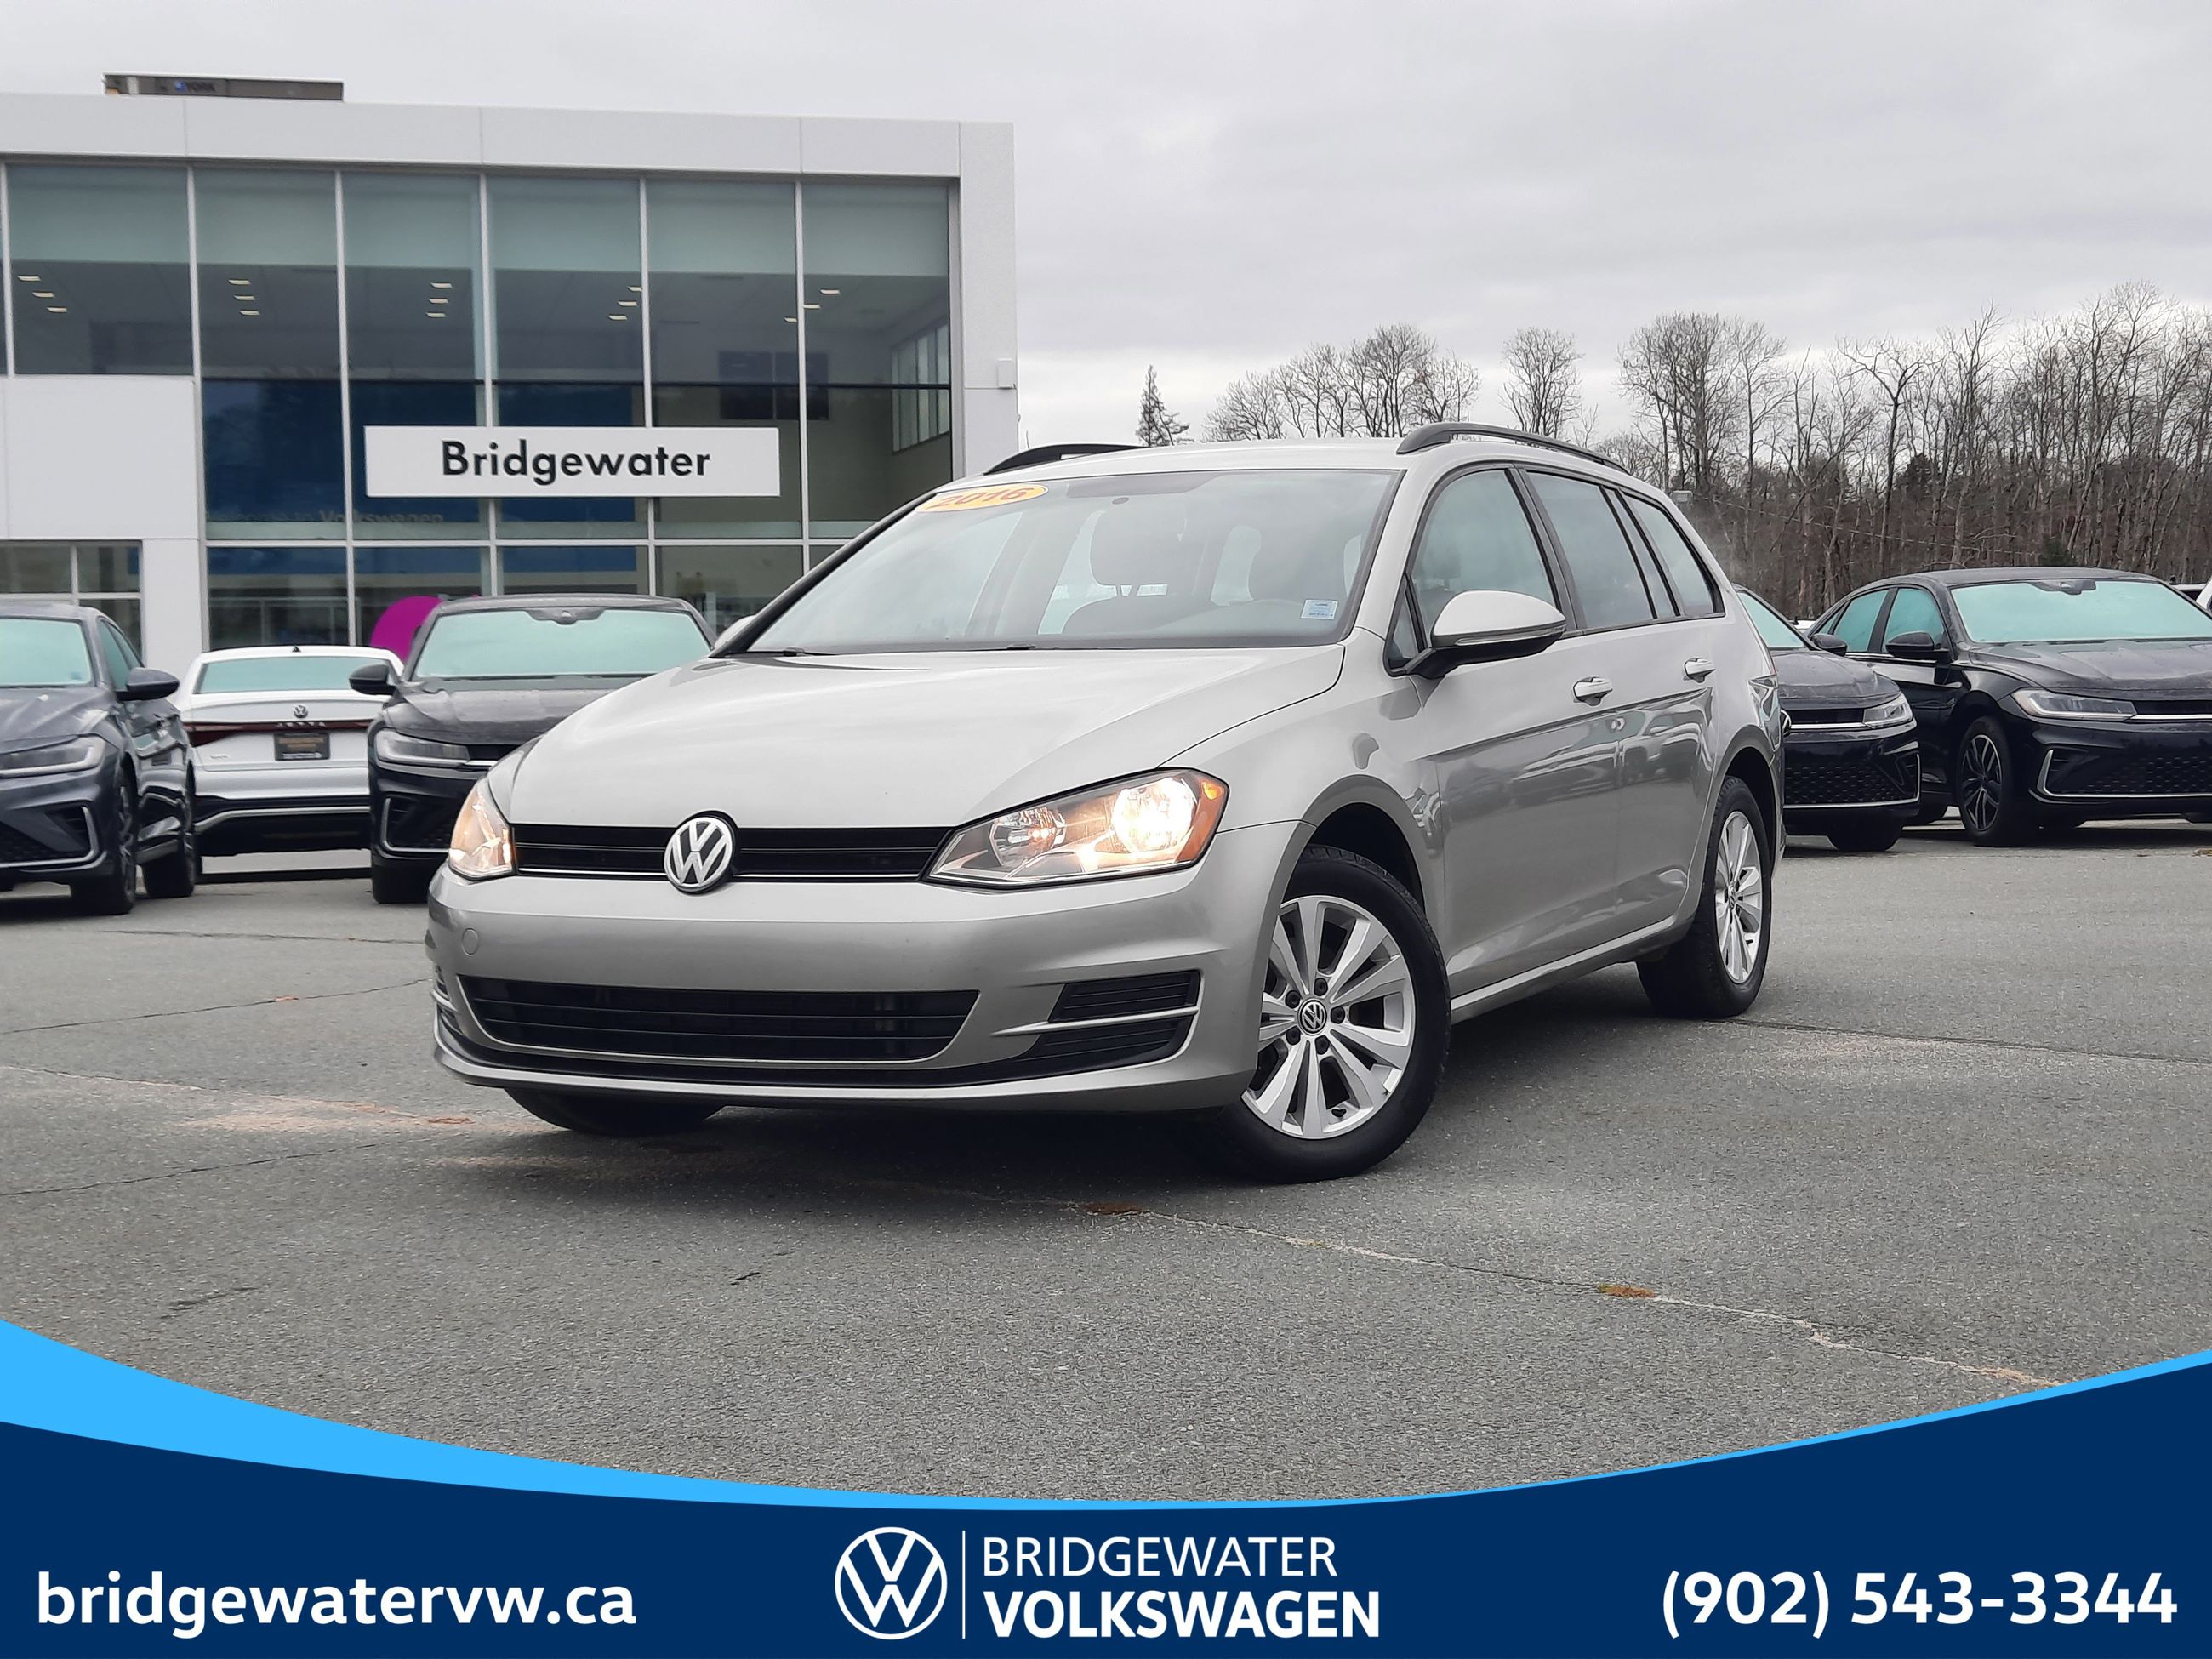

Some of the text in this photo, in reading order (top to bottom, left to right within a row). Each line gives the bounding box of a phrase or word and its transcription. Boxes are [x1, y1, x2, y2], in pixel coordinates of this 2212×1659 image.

[442, 438, 710, 486] Bridgewater
[928, 487, 1035, 509] 2016
[664, 817, 733, 887] VW
